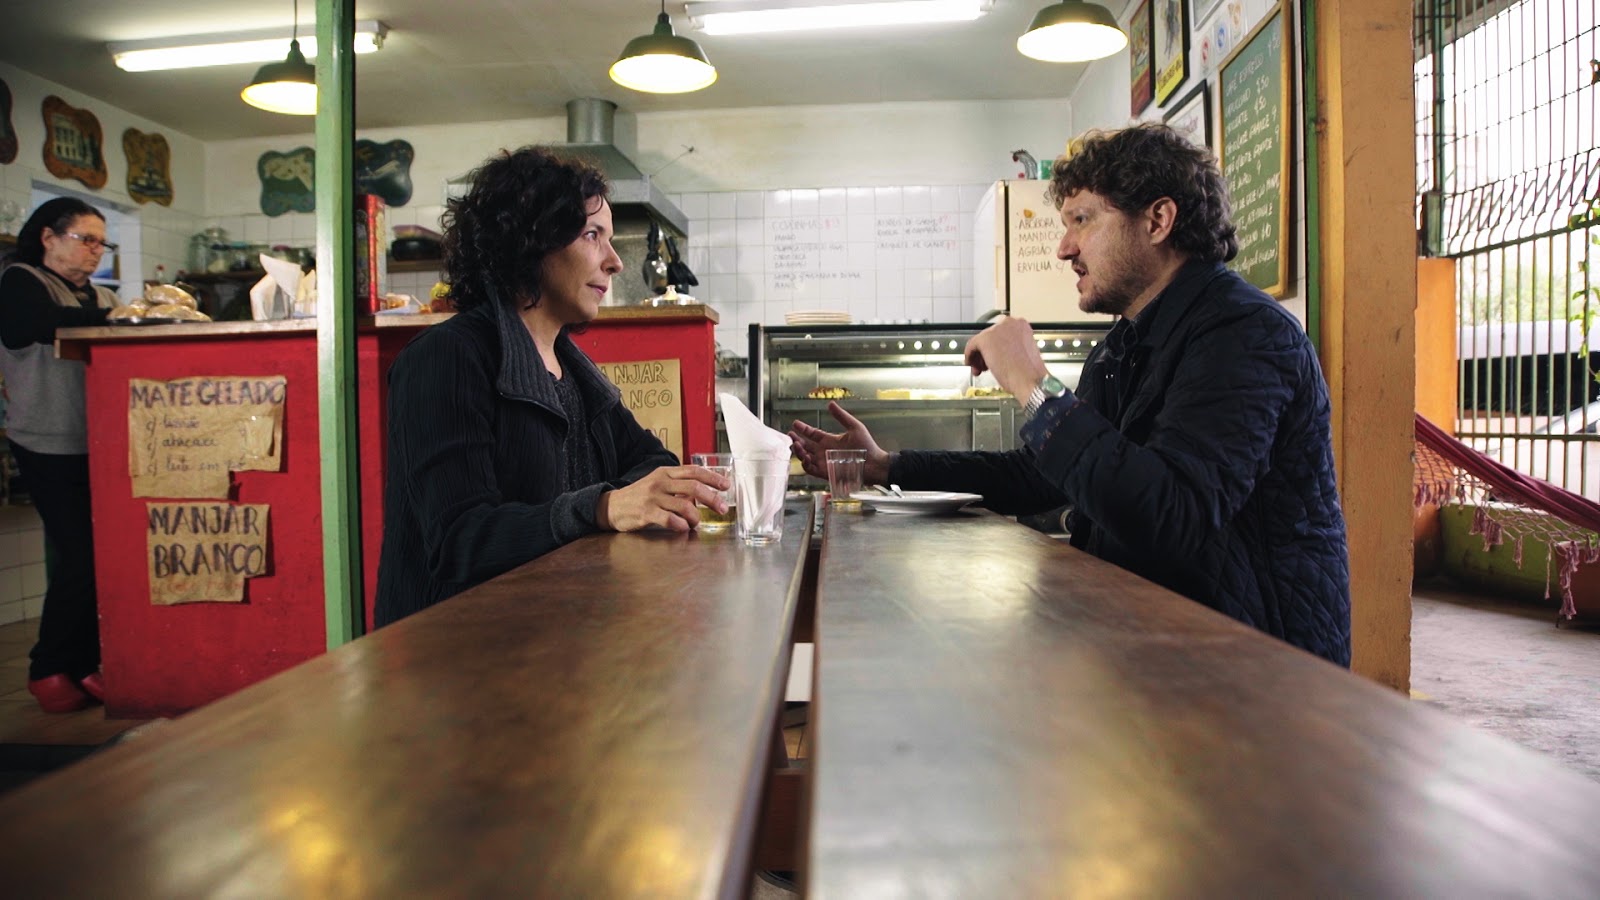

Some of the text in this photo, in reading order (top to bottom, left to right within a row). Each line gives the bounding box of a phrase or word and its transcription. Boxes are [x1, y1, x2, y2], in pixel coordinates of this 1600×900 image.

[1018, 260, 1052, 273] ERVILHA
[130, 378, 285, 409] MATE GELADO
[150, 504, 260, 535] MANJAR
[154, 542, 264, 578] BRANCO
